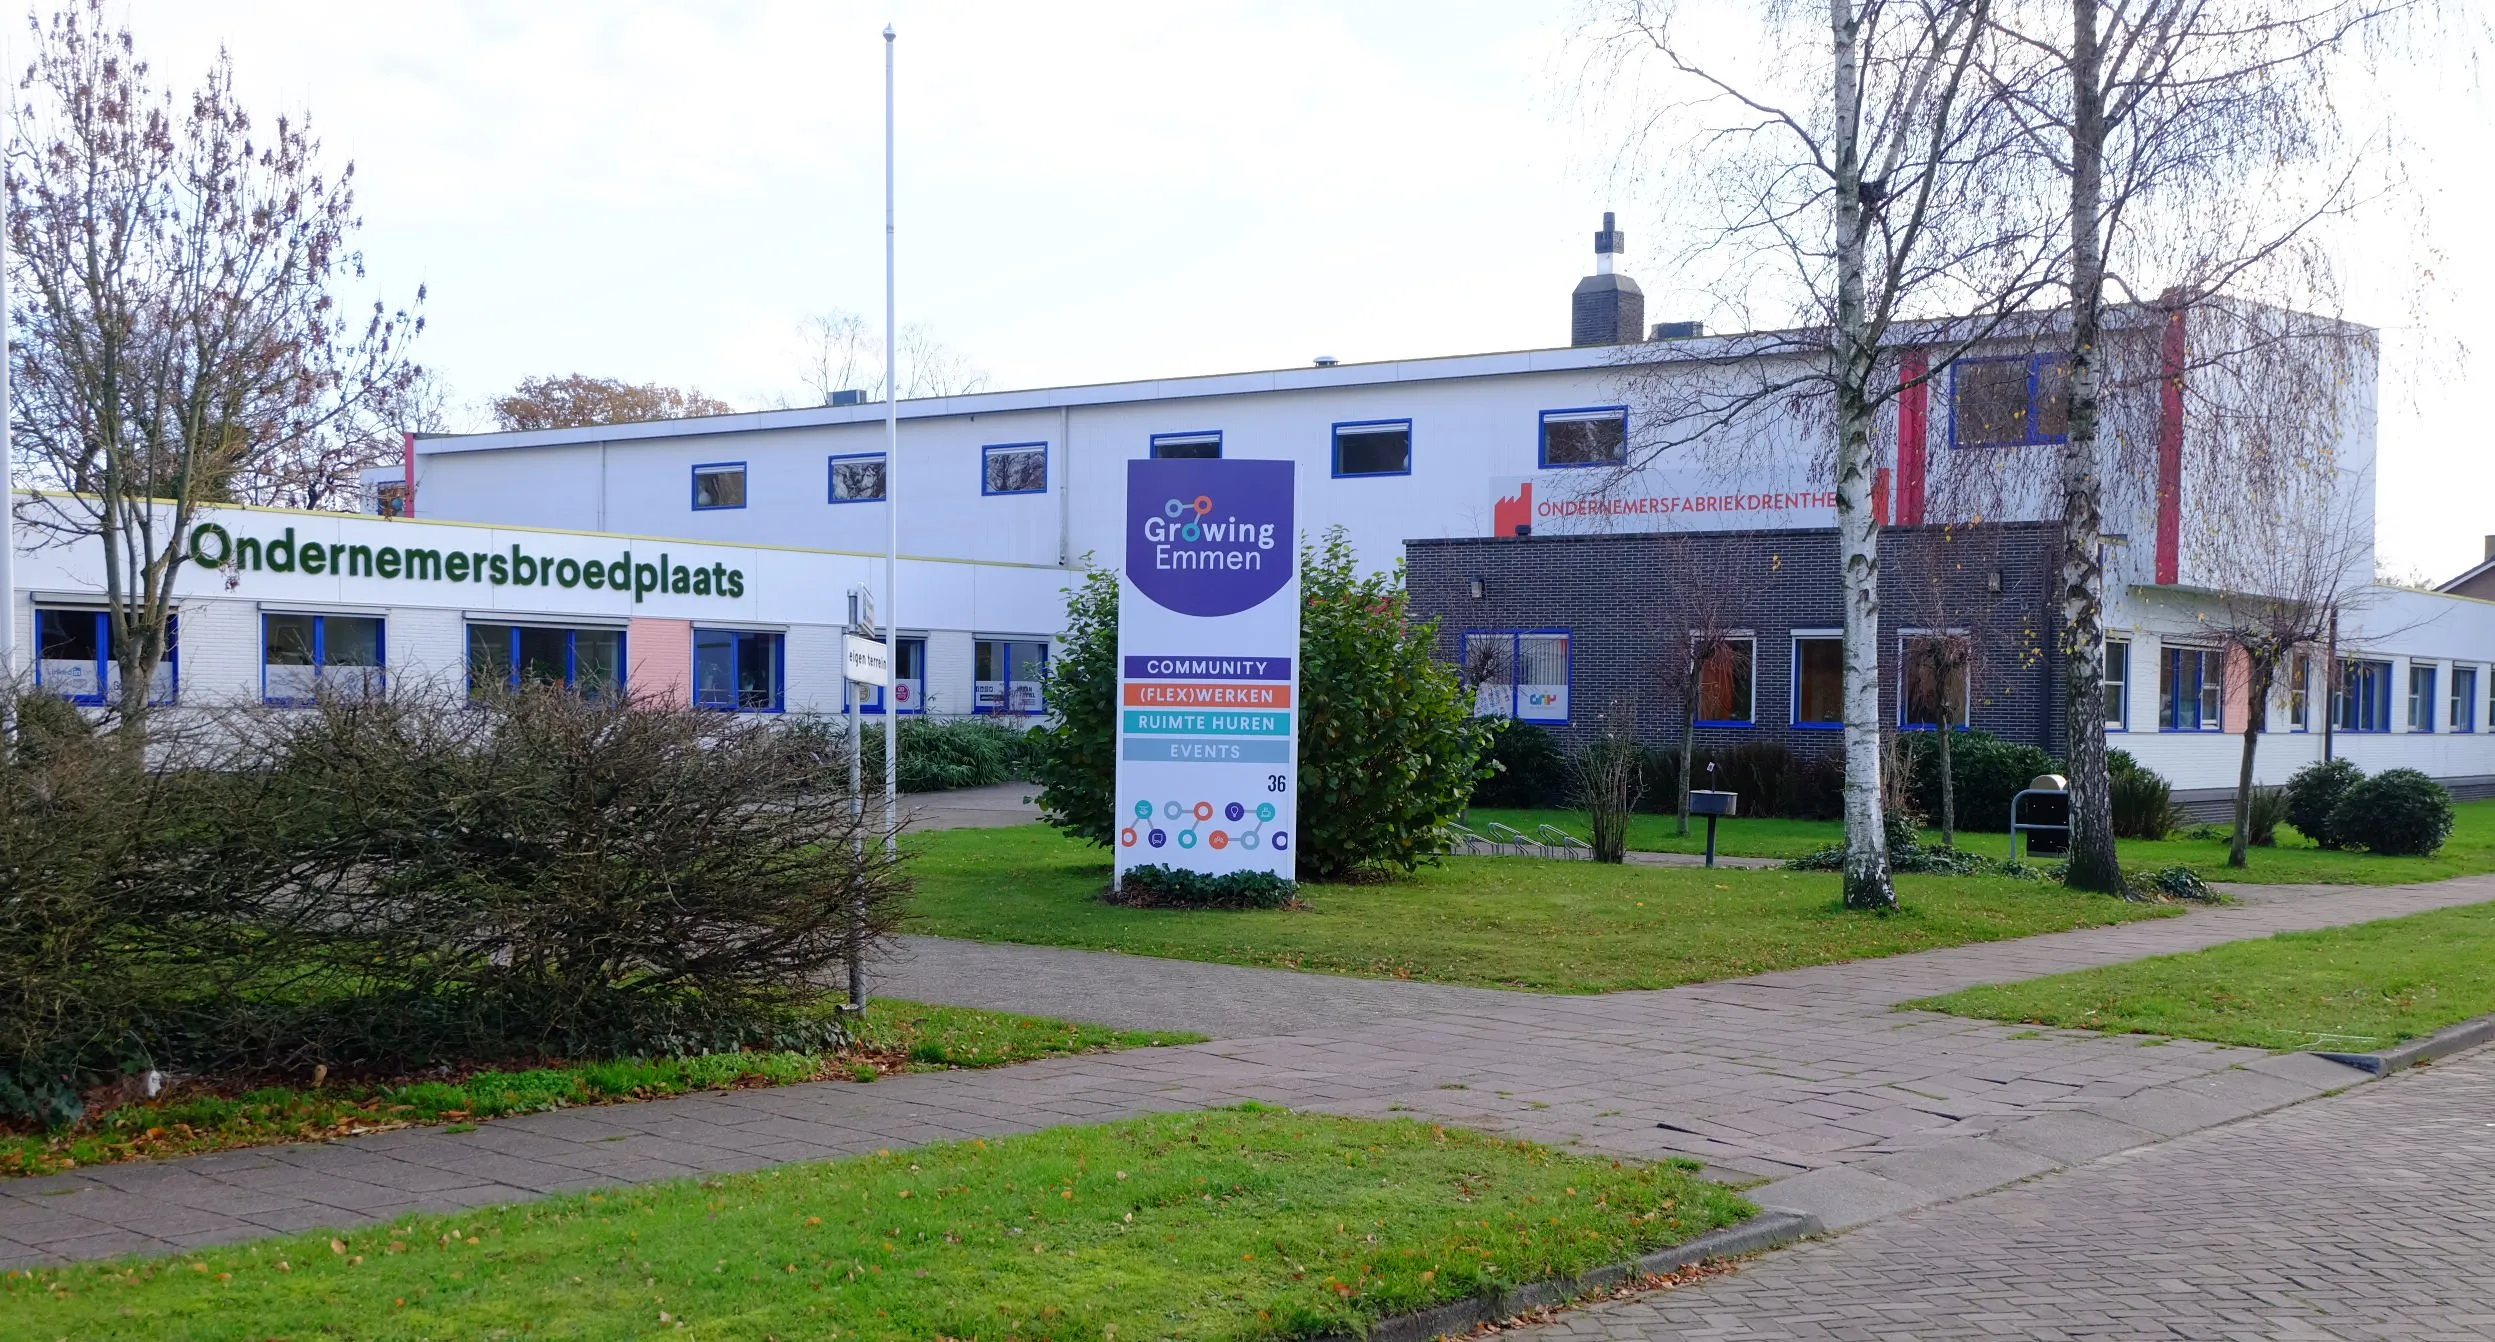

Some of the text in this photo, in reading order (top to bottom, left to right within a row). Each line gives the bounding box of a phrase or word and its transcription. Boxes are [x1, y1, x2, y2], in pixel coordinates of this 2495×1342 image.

[1537, 491, 1837, 518] ONDERNEMERSFABRIEKDRENTHE
[1144, 516, 1275, 549] Growing
[189, 522, 744, 602] Ondernemersbroedplaats
[1156, 544, 1261, 570] Emmen
[849, 649, 887, 670] eigen terrein
[1147, 660, 1268, 675] COMMUNITY
[1140, 687, 1273, 703] (FLEX)WERKEN
[1139, 715, 1275, 731] RUIMTE HUREN
[1171, 744, 1240, 759] EVENTS
[1267, 775, 1286, 792] 36
